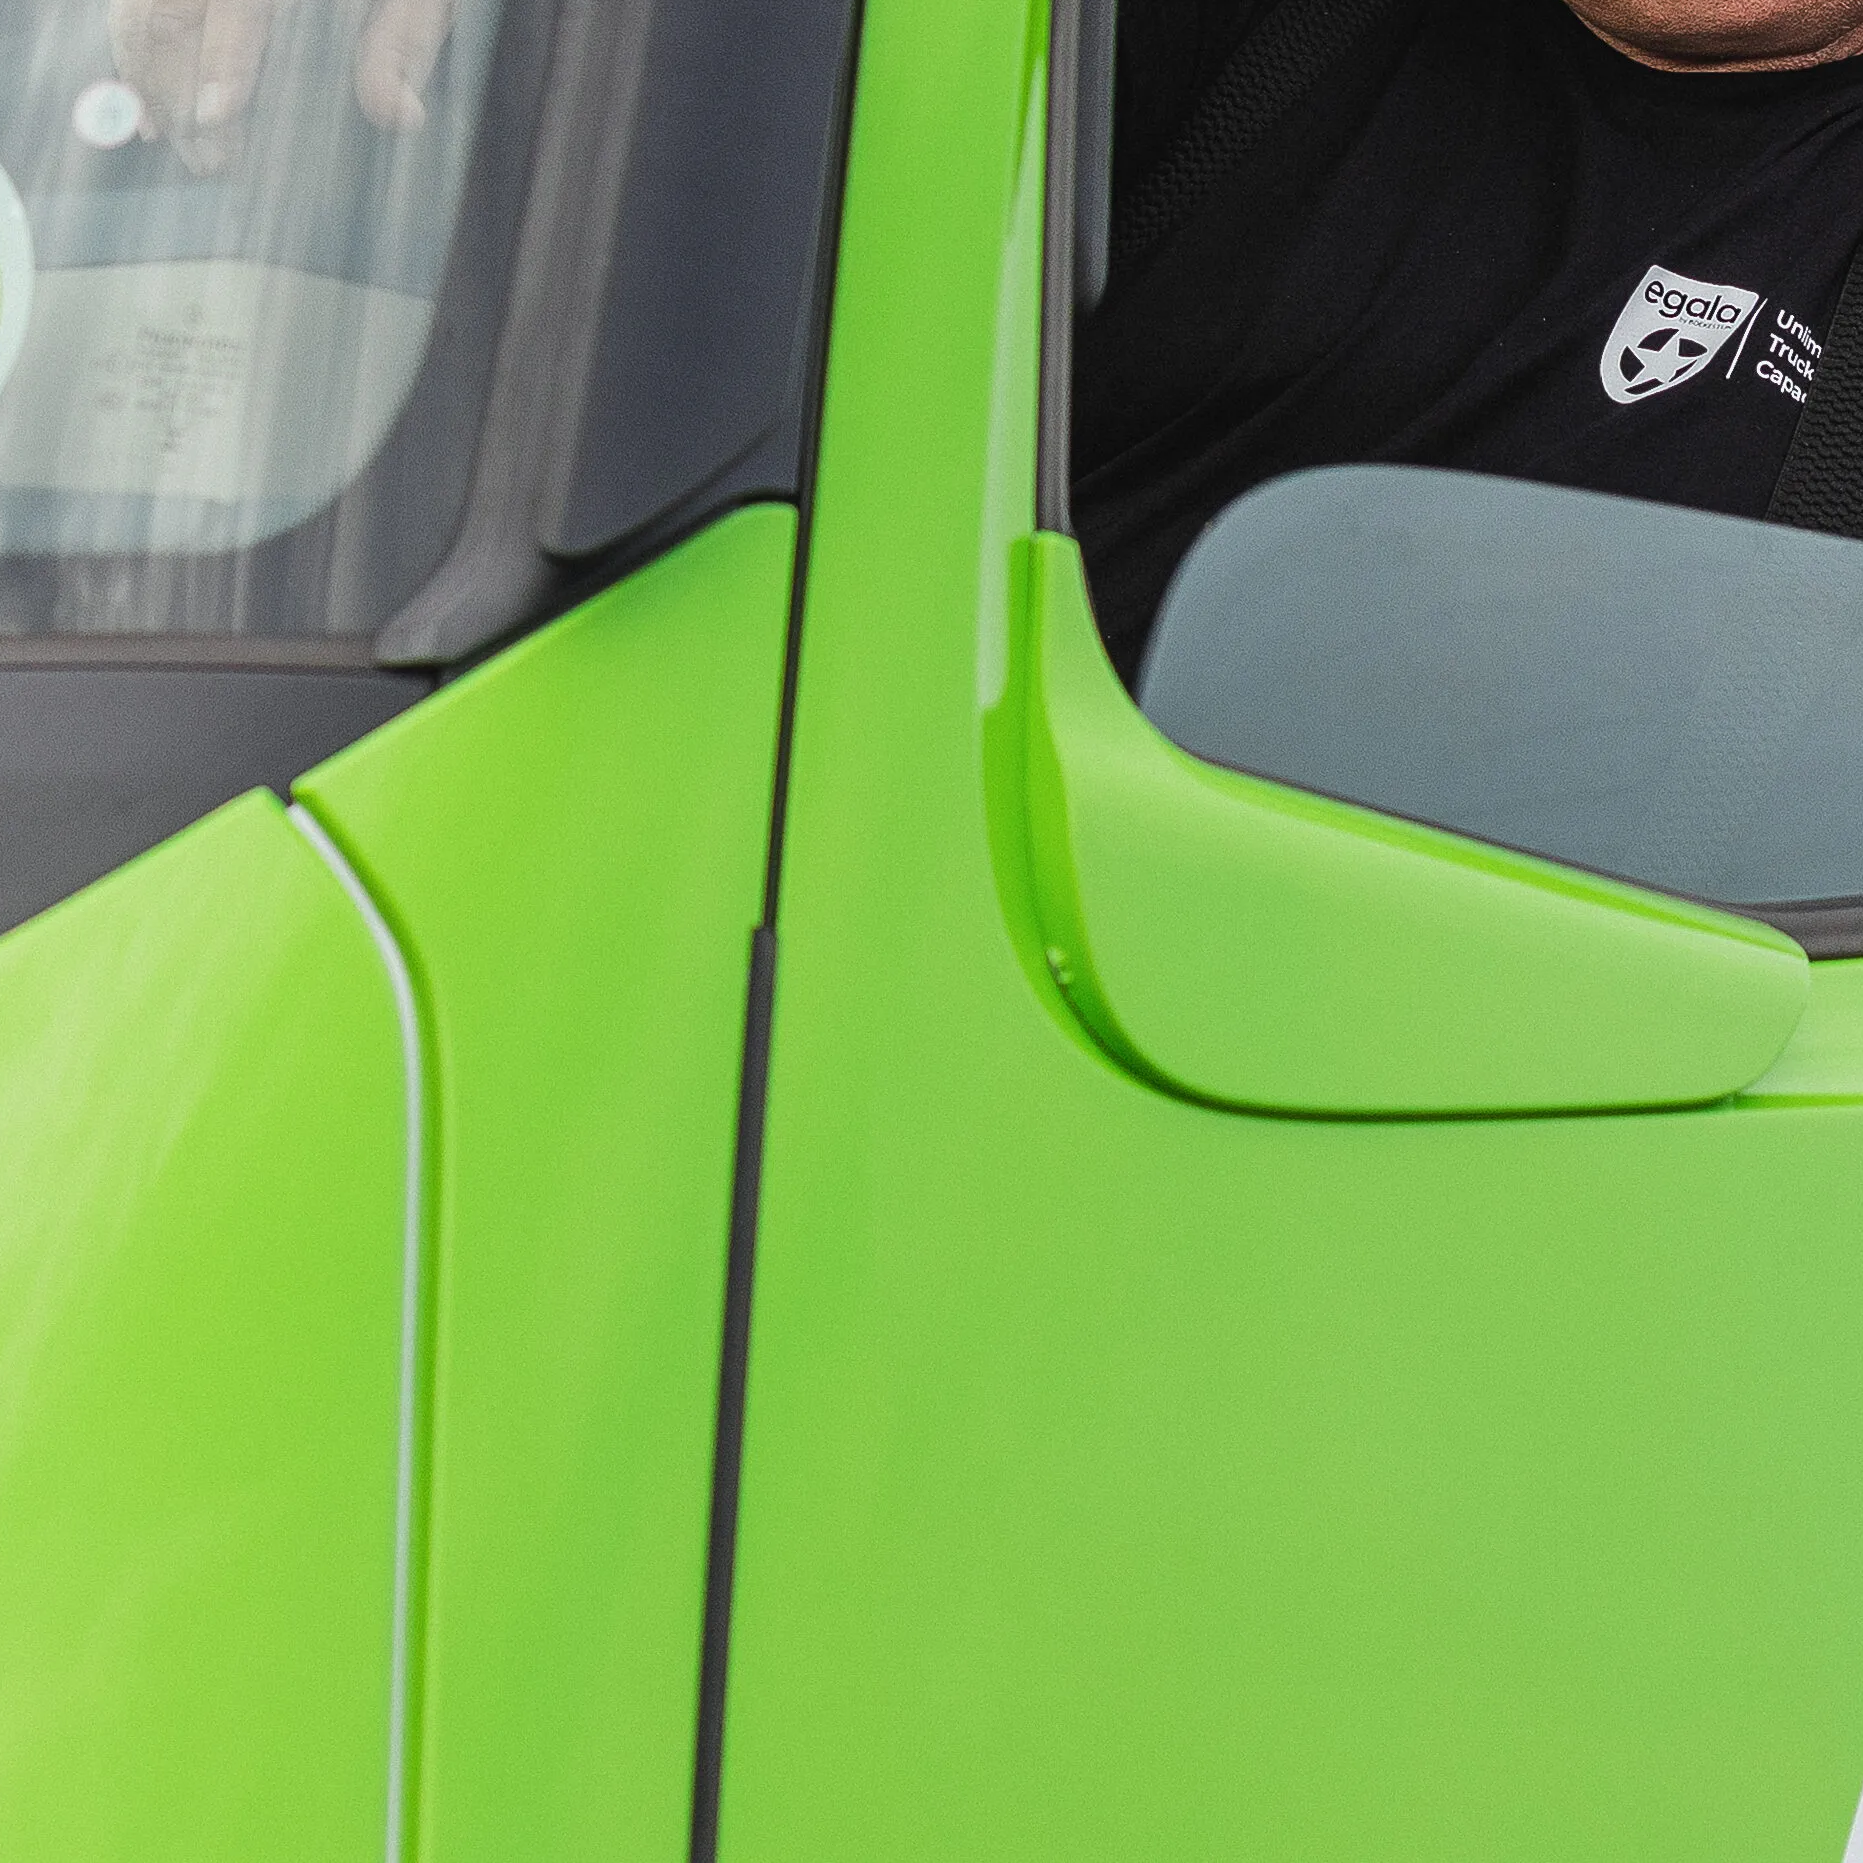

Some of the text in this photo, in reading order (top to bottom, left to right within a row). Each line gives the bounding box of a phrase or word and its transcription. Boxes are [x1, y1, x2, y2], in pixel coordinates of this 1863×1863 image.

[1644, 280, 1742, 324] egala
[1769, 332, 1815, 381] Truck
[1776, 309, 1823, 359] Unlim
[1755, 359, 1808, 404] Capa
